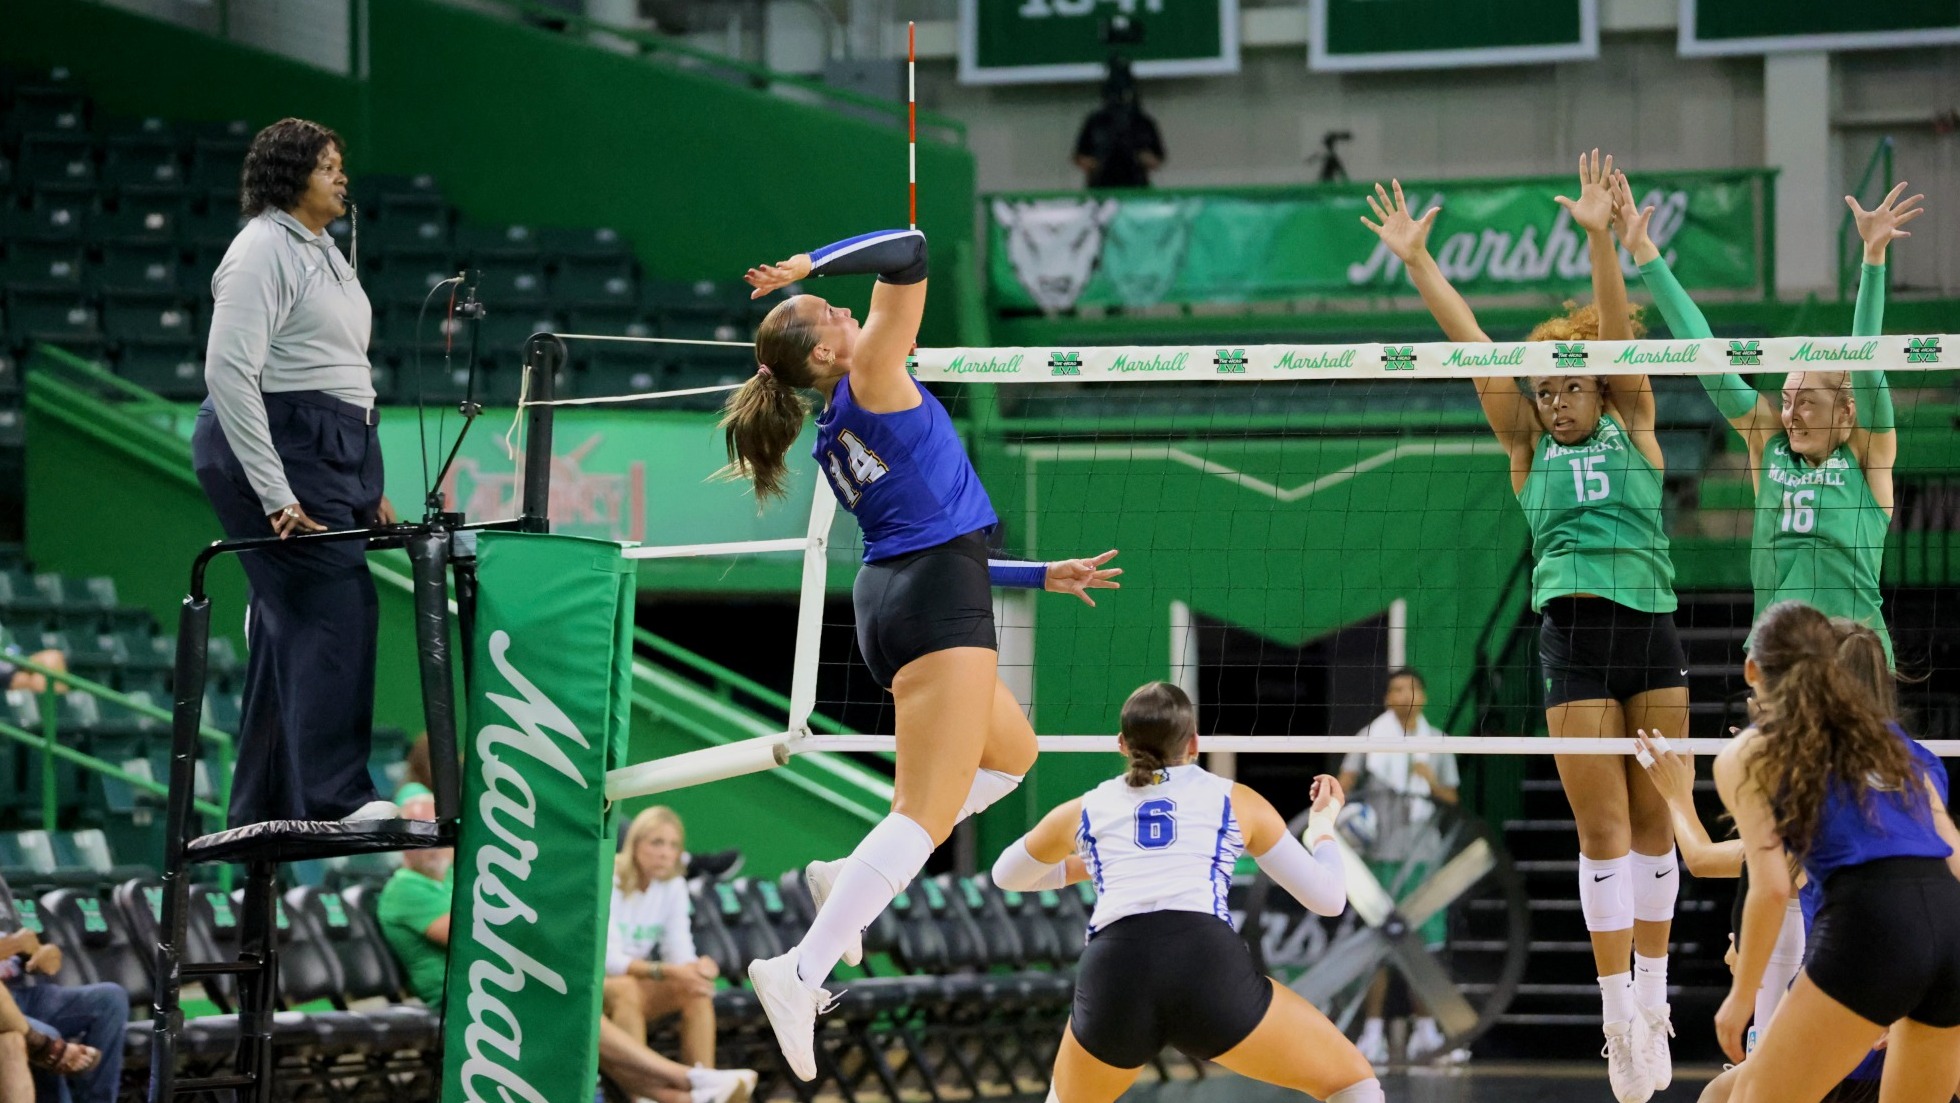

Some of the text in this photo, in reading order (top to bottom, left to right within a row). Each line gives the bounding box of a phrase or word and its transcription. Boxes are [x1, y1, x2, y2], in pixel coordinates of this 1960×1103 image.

[1107, 352, 1190, 372] Marshall
[1273, 350, 1356, 370] Marshall
[1442, 346, 1525, 367] Marshall
[1613, 343, 1701, 365] Marshall
[1789, 341, 1879, 362] Marshall
[943, 354, 1024, 374] Marshall
[827, 429, 890, 508] 14
[1568, 454, 1610, 502] 15
[1781, 489, 1815, 533] 16
[1133, 796, 1178, 851] 6
[461, 629, 591, 1103] Marshal
